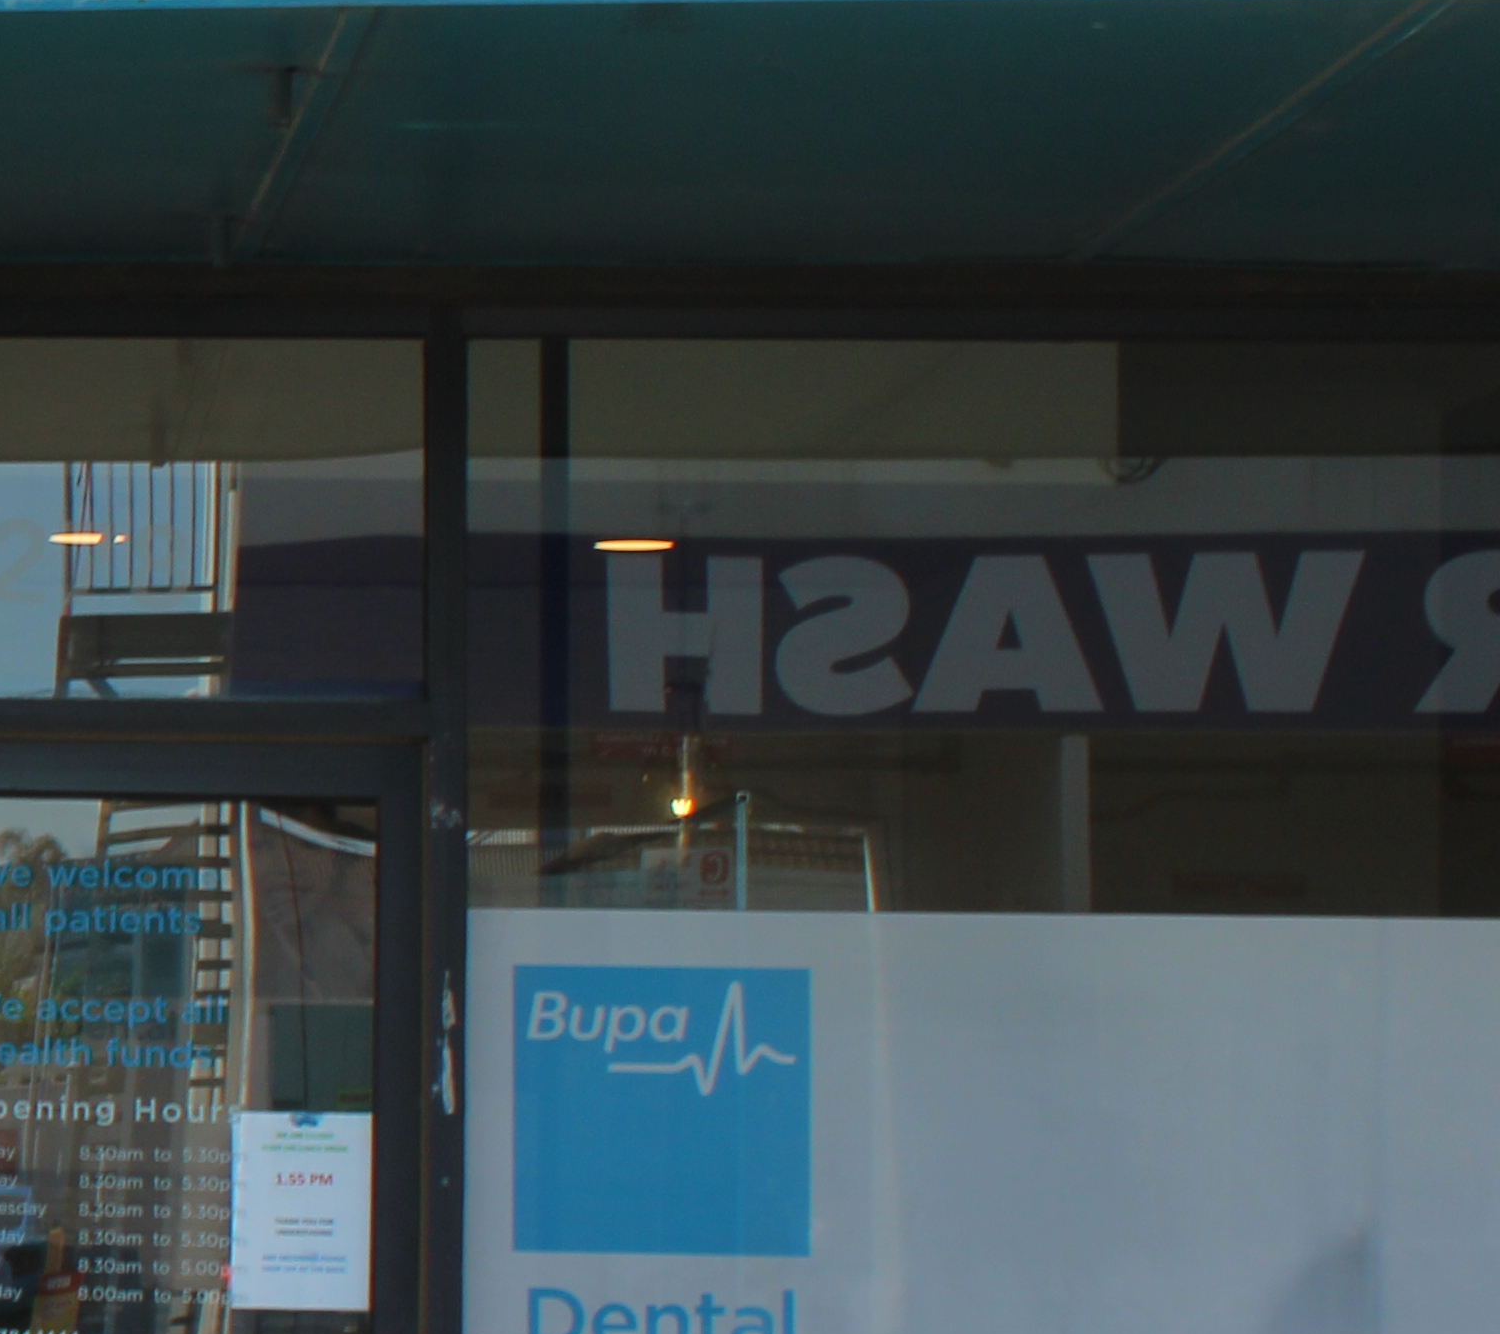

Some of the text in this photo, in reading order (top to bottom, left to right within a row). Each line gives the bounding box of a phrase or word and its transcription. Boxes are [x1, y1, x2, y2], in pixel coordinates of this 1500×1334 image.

[45, 859, 222, 890] welcome
[43, 904, 201, 938] patients
[35, 995, 168, 1030] accept
[181, 994, 226, 1024] all
[525, 989, 689, 1054] Bupa
[105, 1038, 213, 1069] funds
[135, 1096, 243, 1125] Hours
[153, 1148, 172, 1163] to
[181, 1148, 238, 1165] 5.30p
[153, 1177, 171, 1191] to
[181, 1177, 238, 1194] 5.30p
[308, 1173, 334, 1186] PM
[153, 1205, 171, 1219] to
[181, 1205, 238, 1222] 5.30p
[152, 1233, 170, 1247] to
[181, 1233, 238, 1249] 5.30p
[152, 1260, 170, 1275] to
[180, 1261, 238, 1277] 5.00p
[153, 1289, 172, 1304] to
[181, 1290, 238, 1306] 5.00p
